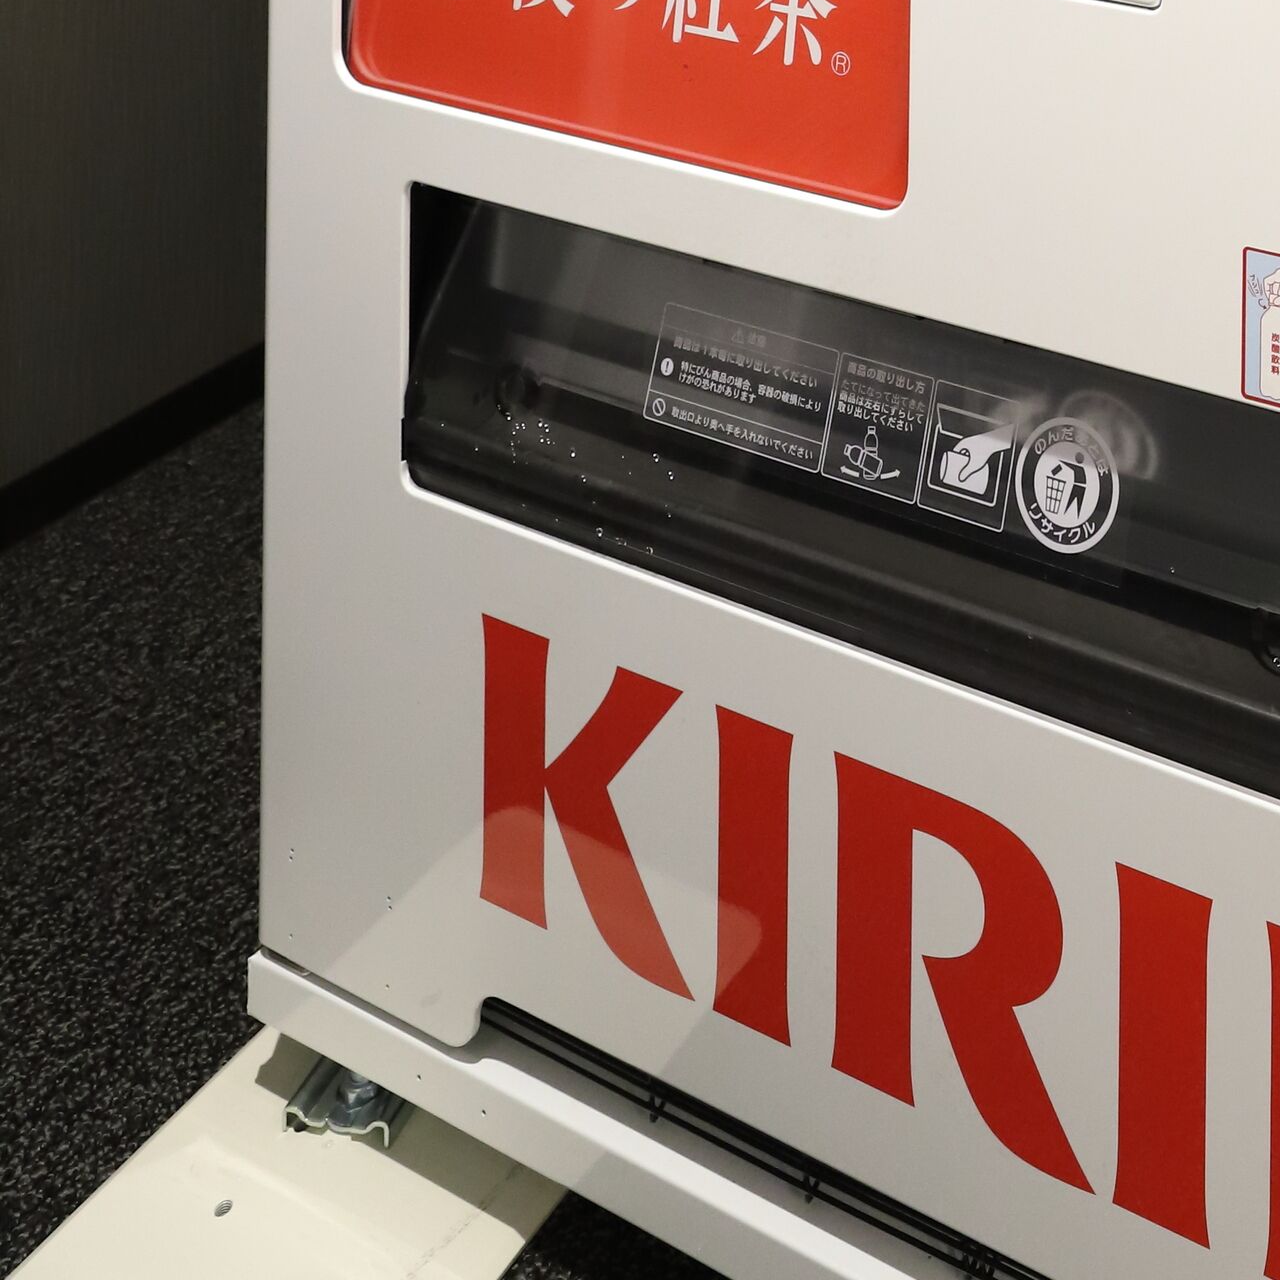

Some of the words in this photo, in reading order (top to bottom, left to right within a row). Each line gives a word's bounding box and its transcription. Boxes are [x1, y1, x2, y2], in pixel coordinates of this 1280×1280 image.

[1270, 332, 1280, 376] 炭酸飲料
[678, 373, 757, 404] けがの恐れがあります
[847, 361, 927, 394] 商品の取り出し方
[839, 390, 924, 425] 商品は左右にずらして
[840, 379, 926, 413] たてになって出てきた
[671, 406, 813, 460] 取出口より奥へ手を入れないでください
[837, 400, 913, 432] 取り出してください
[1028, 502, 1096, 544] リサイクル
